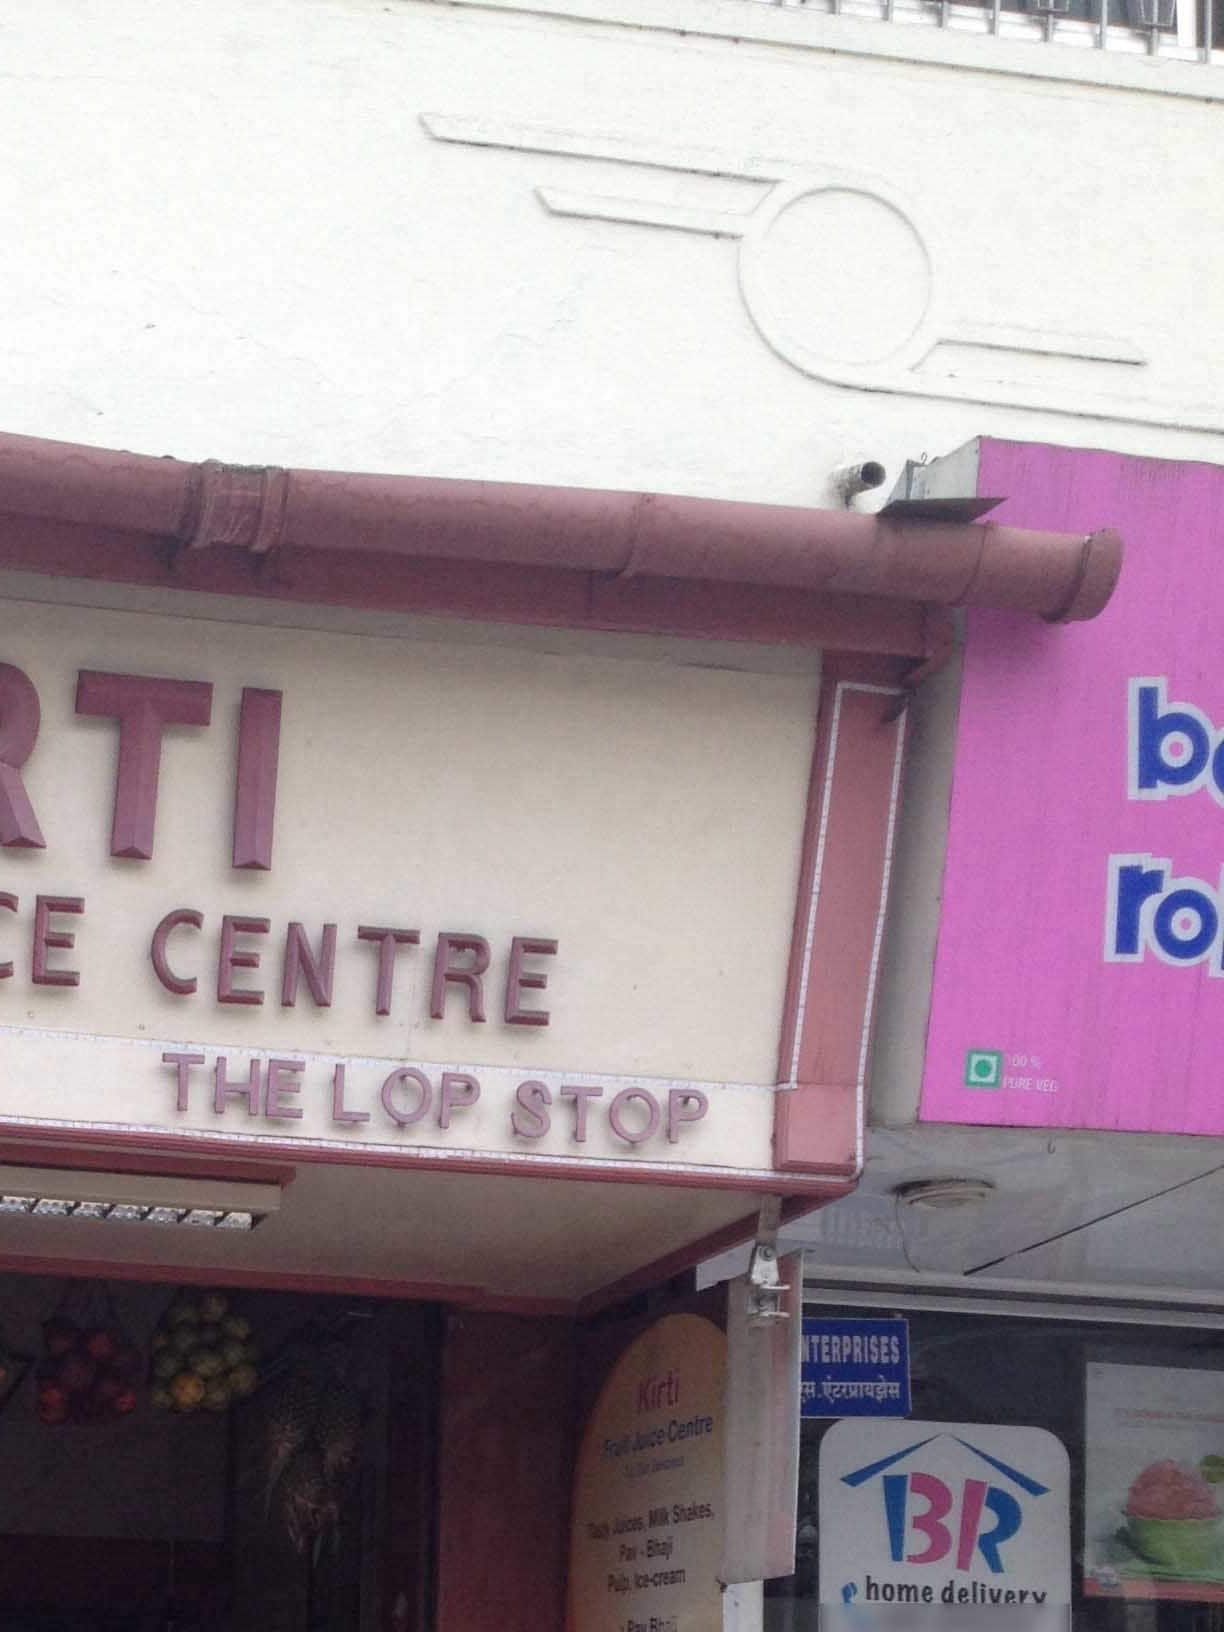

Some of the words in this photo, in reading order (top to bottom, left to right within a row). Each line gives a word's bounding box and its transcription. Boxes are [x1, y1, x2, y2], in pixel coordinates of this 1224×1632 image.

[1128, 676, 1224, 808] b
[150, 908, 558, 1027] CENTRE
[162, 1052, 304, 1119] THE
[332, 1063, 482, 1129] LOP
[511, 1079, 709, 1145] STOP
[1002, 1075, 1032, 1090] PURE
[801, 1335, 900, 1363] NTERPRISES
[668, 1415, 713, 1443] Centre
[883, 1471, 1023, 1573] BR
[866, 1575, 934, 1601] home
[941, 1579, 1047, 1604] delivery
